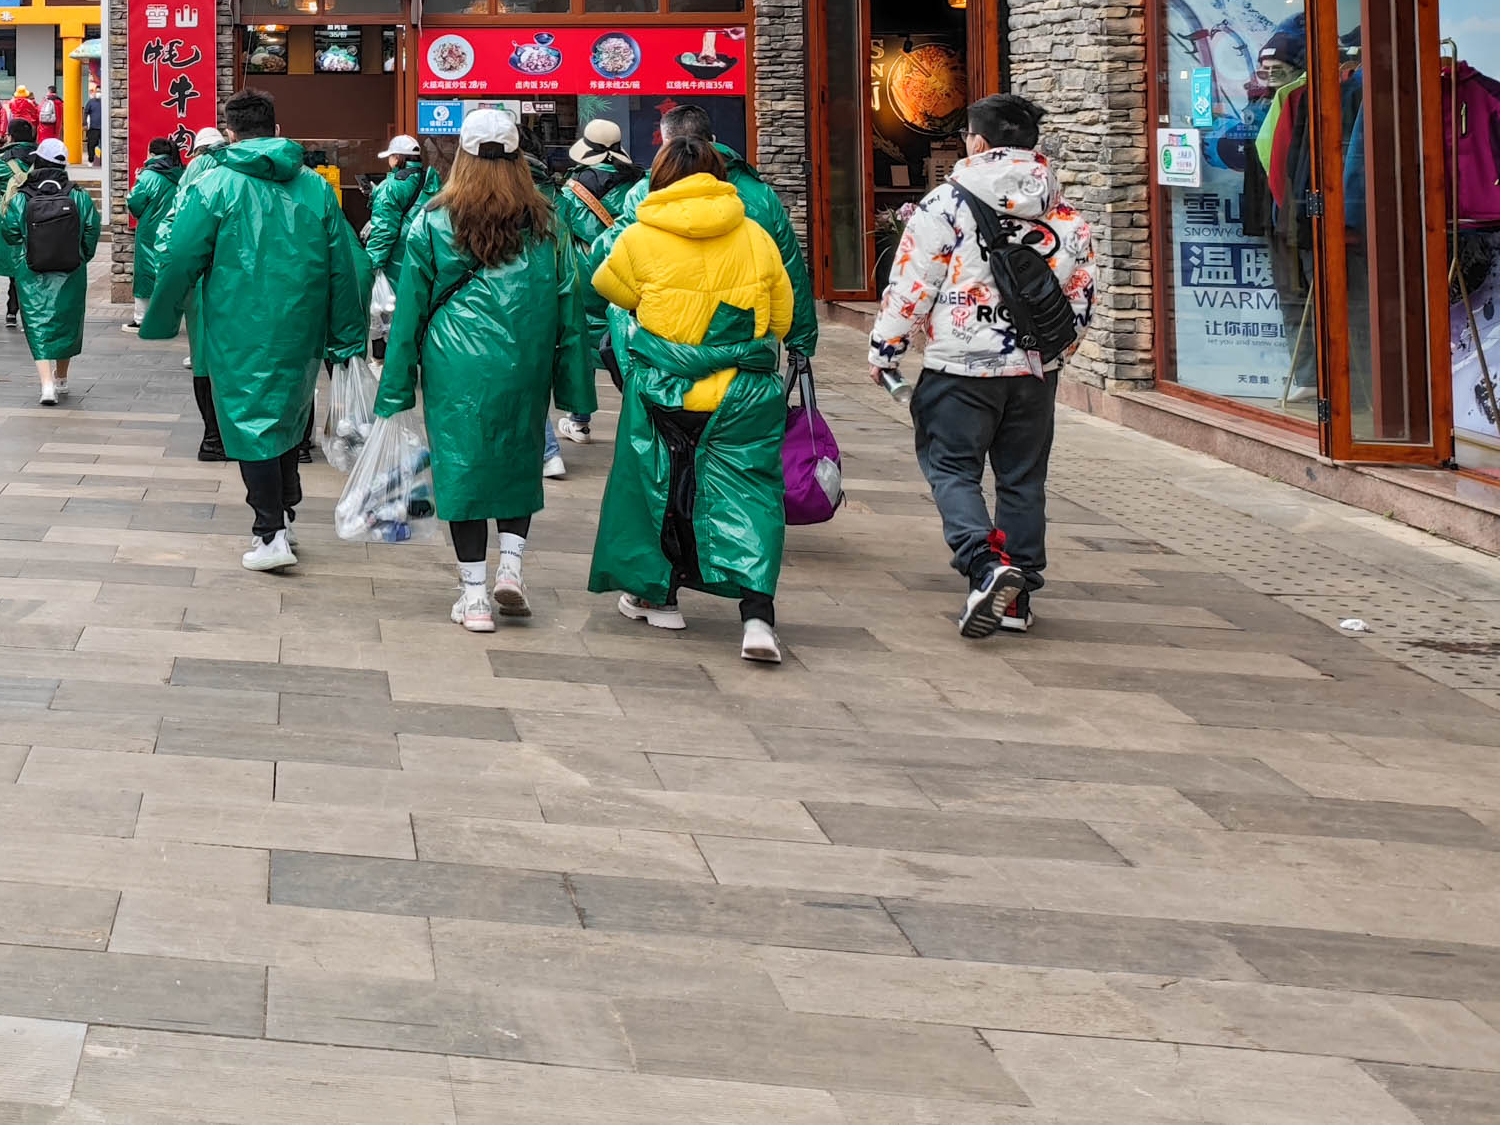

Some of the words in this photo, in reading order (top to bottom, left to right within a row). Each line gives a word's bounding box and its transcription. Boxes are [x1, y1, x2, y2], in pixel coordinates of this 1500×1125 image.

[145, 3, 199, 28] 雪山
[1189, 245, 1274, 288] 温暖
[1193, 290, 1279, 311] WARM
